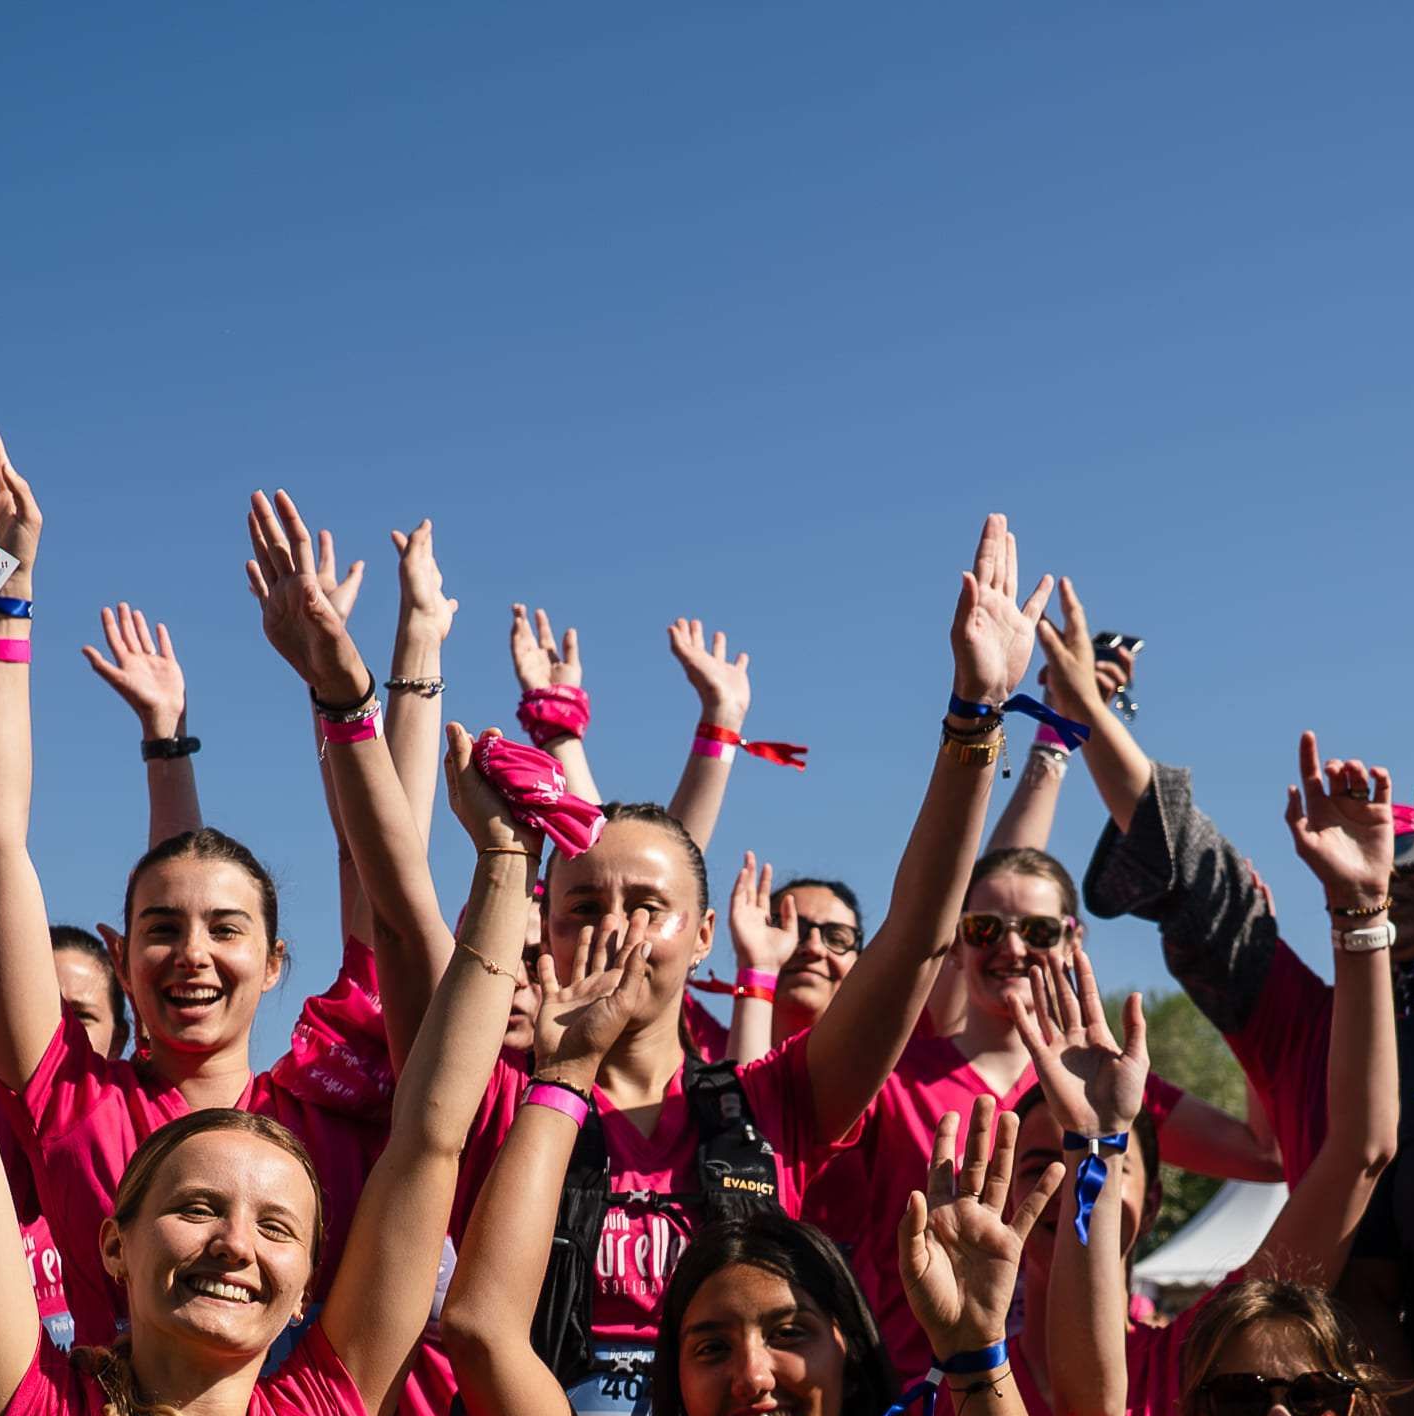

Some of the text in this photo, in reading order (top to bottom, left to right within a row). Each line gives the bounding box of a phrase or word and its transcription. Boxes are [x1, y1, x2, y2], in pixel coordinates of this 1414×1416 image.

[723, 1176, 775, 1195] EVADICT
[602, 1279, 664, 1296] SOLIDA
[600, 1375, 645, 1402] 40
